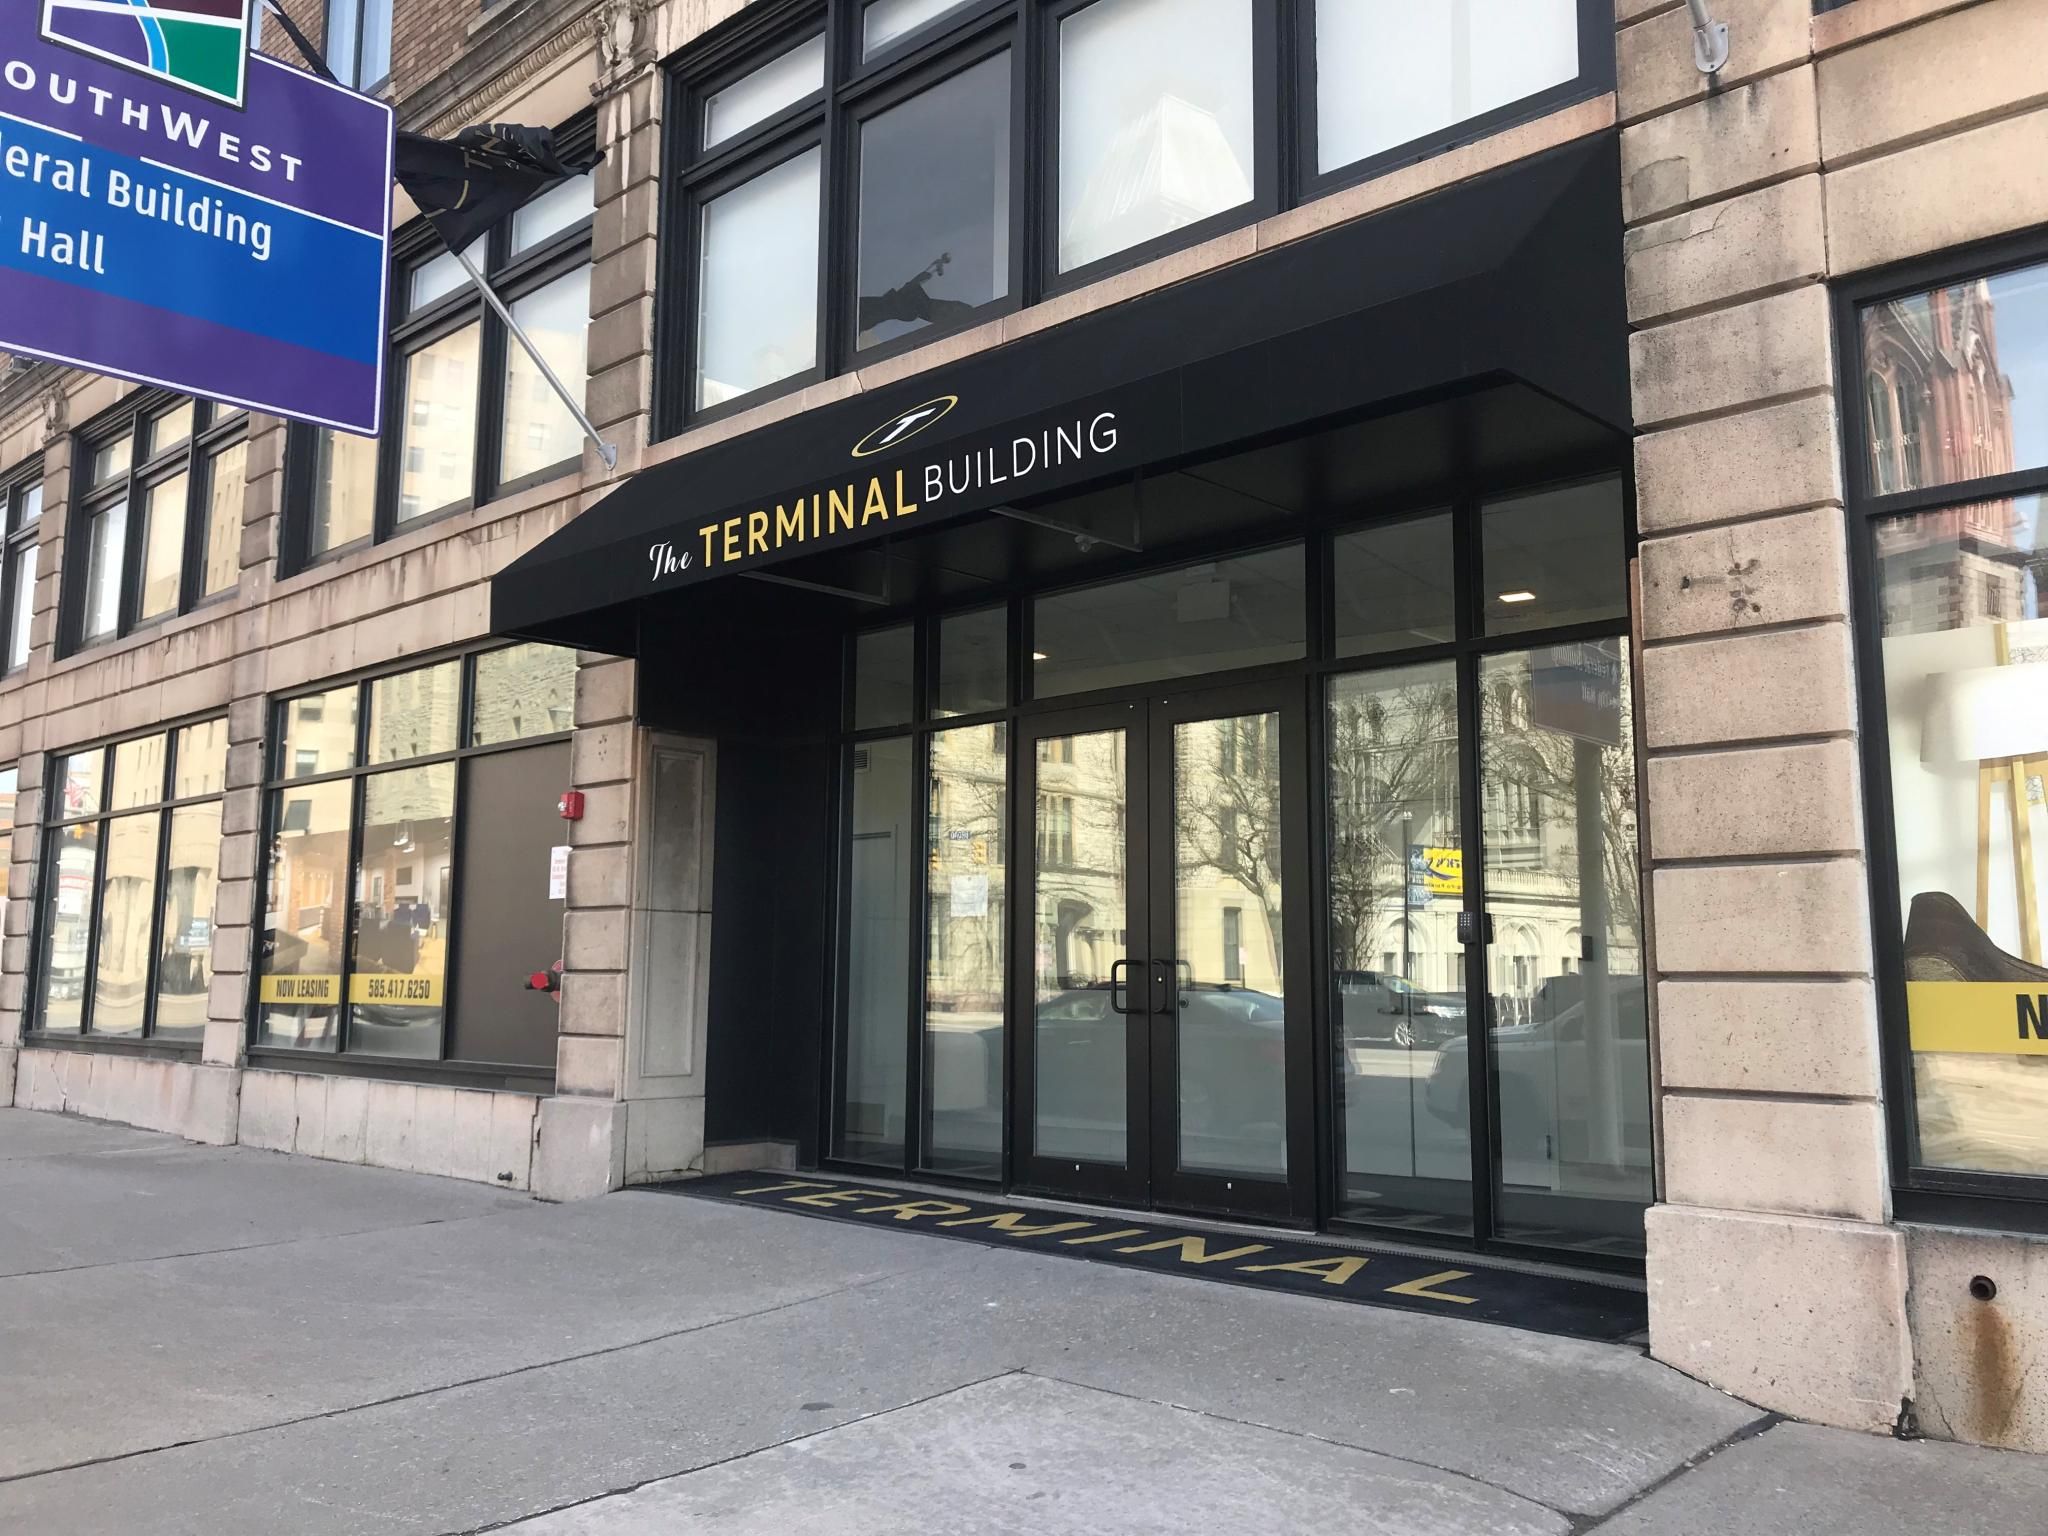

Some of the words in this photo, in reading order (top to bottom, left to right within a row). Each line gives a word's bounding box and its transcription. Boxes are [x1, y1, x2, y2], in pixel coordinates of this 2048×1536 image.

[0, 132, 91, 198] eral
[107, 169, 273, 261] Building
[21, 216, 105, 275] Hall
[648, 540, 693, 582] The
[698, 469, 918, 568] TERMINAL
[924, 412, 1118, 503] BUILDING
[276, 979, 295, 998] NOW
[297, 979, 329, 998] LEASING
[368, 978, 431, 1000] 585.417.6250
[733, 1180, 1480, 1305] TERMINAL
